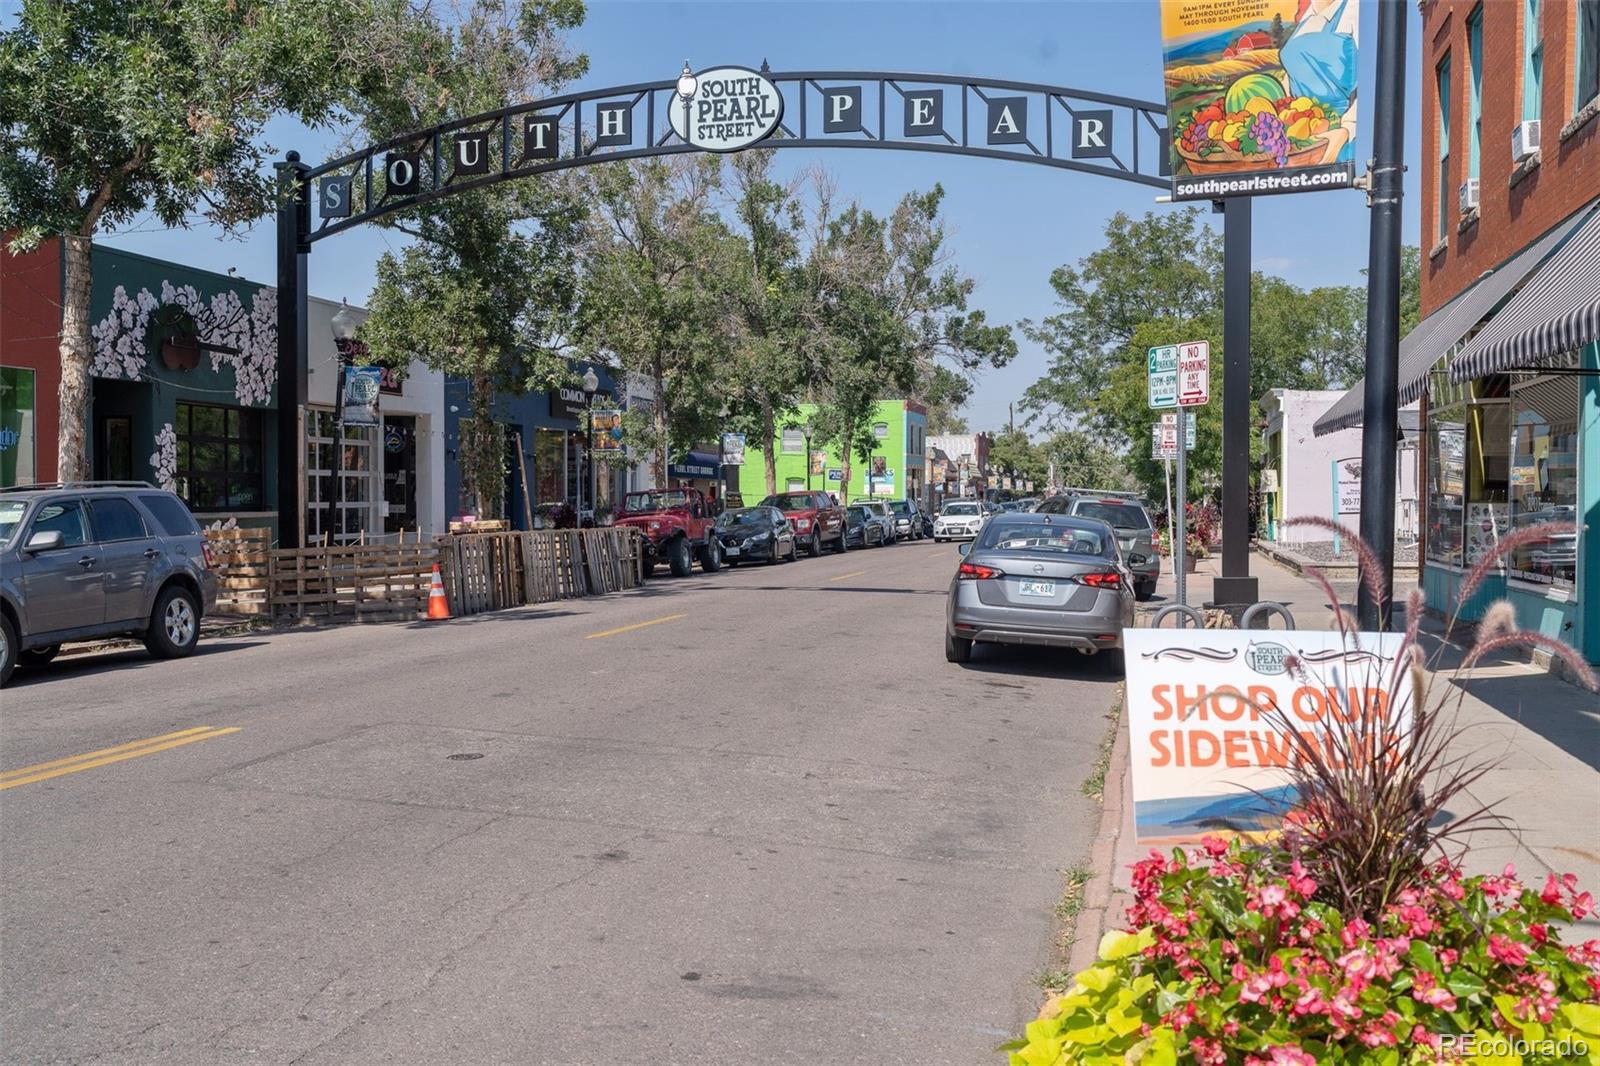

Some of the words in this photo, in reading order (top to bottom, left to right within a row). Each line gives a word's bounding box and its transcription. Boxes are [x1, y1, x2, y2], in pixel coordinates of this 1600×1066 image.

[1194, 9, 1229, 18] THROUGH
[1231, 3, 1269, 13] NOVEMBER
[1214, 1, 1235, 9] EVERY
[1243, 10, 1264, 18] PEARL
[701, 77, 761, 98] SOUTH
[697, 95, 775, 128] PEARL
[829, 95, 1106, 148] PEAR
[697, 121, 755, 141] STREET
[1177, 170, 1348, 195] southpearlstreet.com
[1150, 353, 1156, 369] 2
[1162, 349, 1171, 358] HR
[1187, 346, 1199, 358] NO
[1180, 359, 1206, 373] PARKING
[1187, 380, 1200, 389] TIME
[560, 388, 585, 403] COMMON
[1341, 497, 1360, 506] 303-77
[1257, 646, 1283, 655] SOUTH
[1256, 654, 1287, 664] PEAR
[1257, 664, 1282, 672] STREET
[1151, 684, 1277, 722] SHOP
[1292, 685, 1389, 723] OUR
